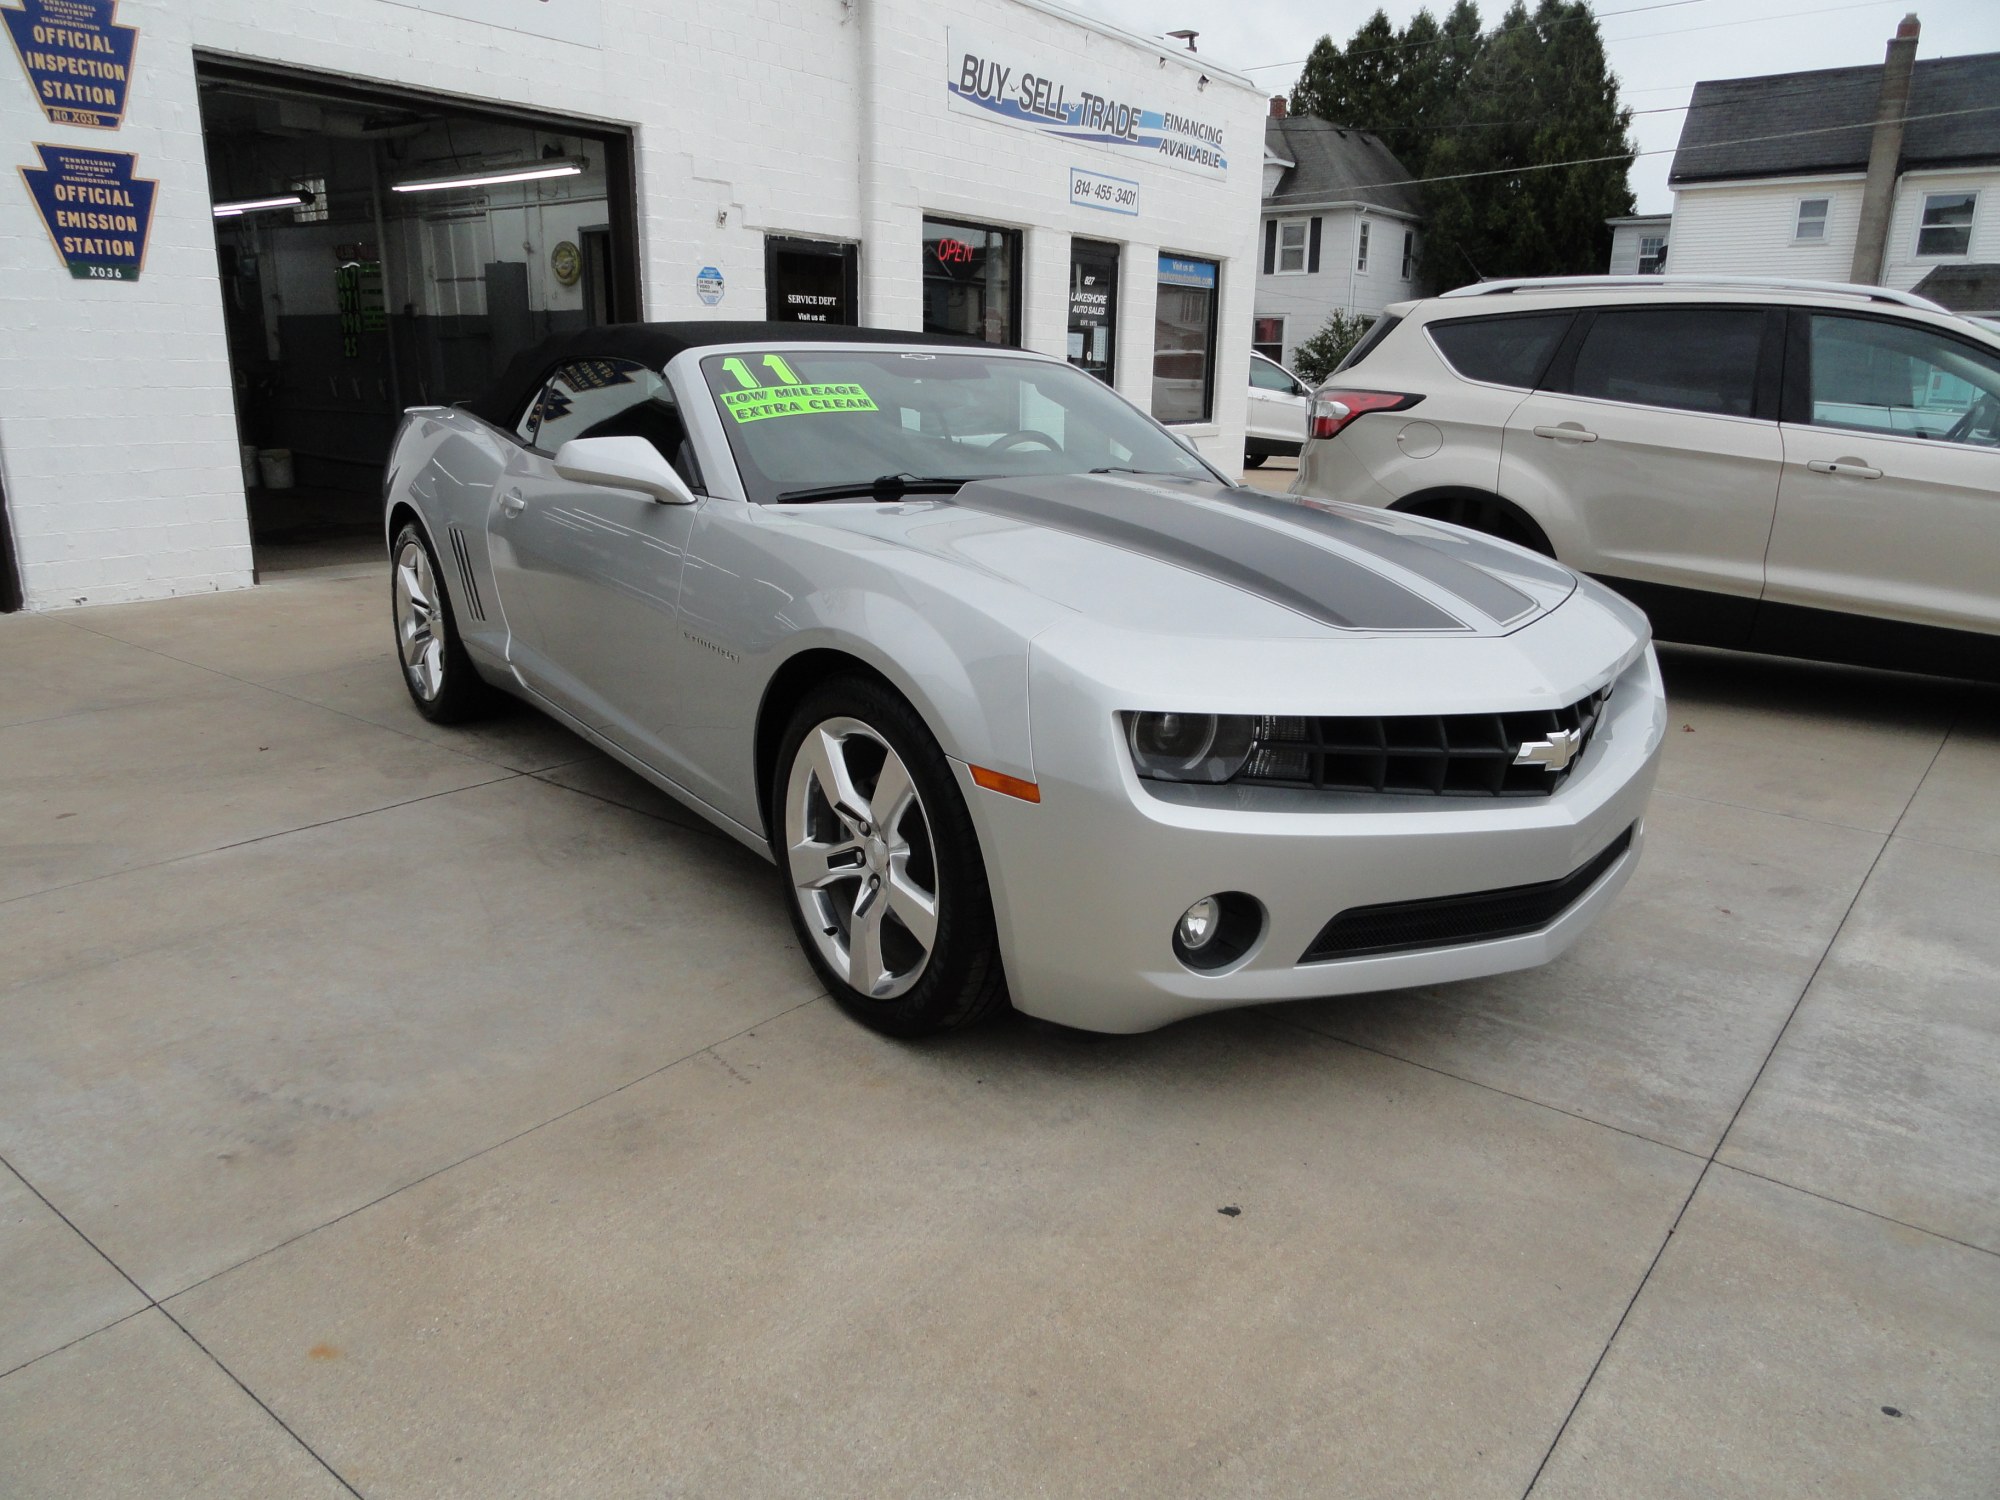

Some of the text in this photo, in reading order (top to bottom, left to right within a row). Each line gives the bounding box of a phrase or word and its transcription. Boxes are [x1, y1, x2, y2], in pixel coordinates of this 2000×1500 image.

[43, 5, 94, 18] DEPARTMENT
[40, 16, 100, 31] TRANSPORTATION
[33, 25, 114, 54] OFFICIAL
[26, 51, 125, 82] INSPECTION
[43, 80, 116, 105] STATION
[959, 54, 1142, 141] BUY SELL TRADE
[72, 111, 100, 125] X036
[1163, 112, 1223, 145] FINANCING
[59, 156, 117, 168] PENNSYLVANIA
[1159, 138, 1221, 169] AVAILABLE
[64, 163, 114, 174] DEPARTMENT
[62, 175, 120, 186] TRANSPORTATION
[54, 183, 134, 207] OFFICIAL
[1074, 179, 1136, 206] 814-455-3401
[56, 210, 138, 233] EMISSION
[63, 236, 136, 257] STATION
[937, 239, 974, 263] OPEN
[89, 266, 122, 279] X036
[788, 294, 837, 306] SERVICE DEPT
[1070, 292, 1107, 304] LAKESHORE
[797, 312, 811, 321] Visit
[1072, 305, 1105, 316] AUTO SALES
[722, 354, 802, 388] 11
[725, 385, 863, 405] LOW MILEAGE
[735, 398, 872, 420] EXTRA CLEAN
